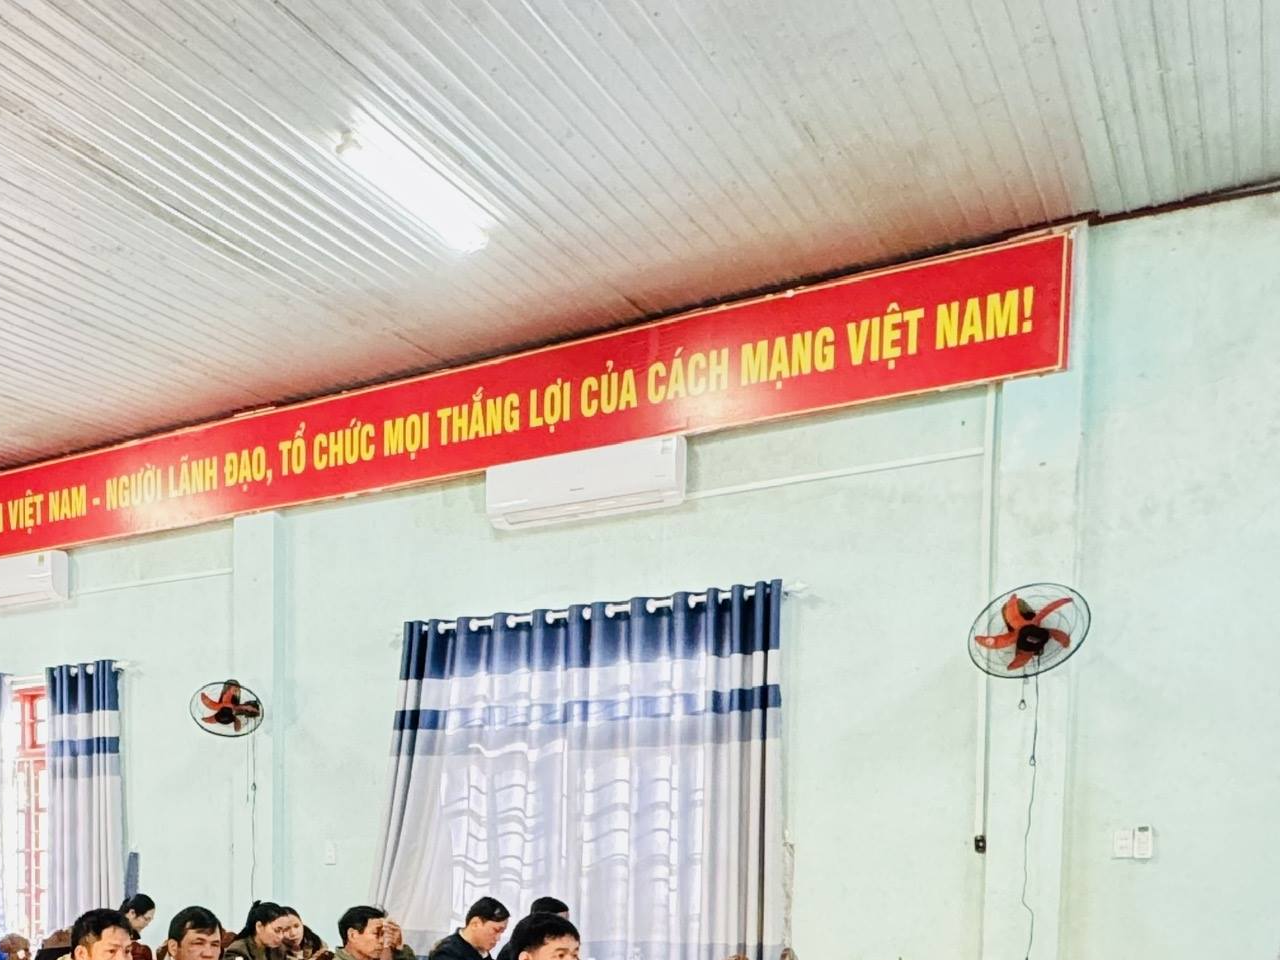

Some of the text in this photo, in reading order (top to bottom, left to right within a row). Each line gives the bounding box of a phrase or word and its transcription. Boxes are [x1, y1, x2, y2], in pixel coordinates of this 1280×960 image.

[8, 489, 44, 534] VIỆT
[48, 485, 86, 522] NAM
[92, 497, 101, 506] -
[105, 463, 162, 511] NGƯỜI
[168, 454, 218, 498] LÃNH
[224, 446, 272, 492] ĐẠO,
[278, 421, 306, 476] TỔ
[313, 417, 375, 470] CHỨC
[383, 412, 430, 460] MỌI
[437, 386, 520, 445] THẮNG
[529, 378, 571, 433] LỢI
[581, 360, 637, 417] CỦA
[647, 346, 729, 404] CÁCH
[740, 326, 835, 390] MẠNG
[846, 302, 925, 369] VIỆT
[935, 286, 1035, 350] NAM!
